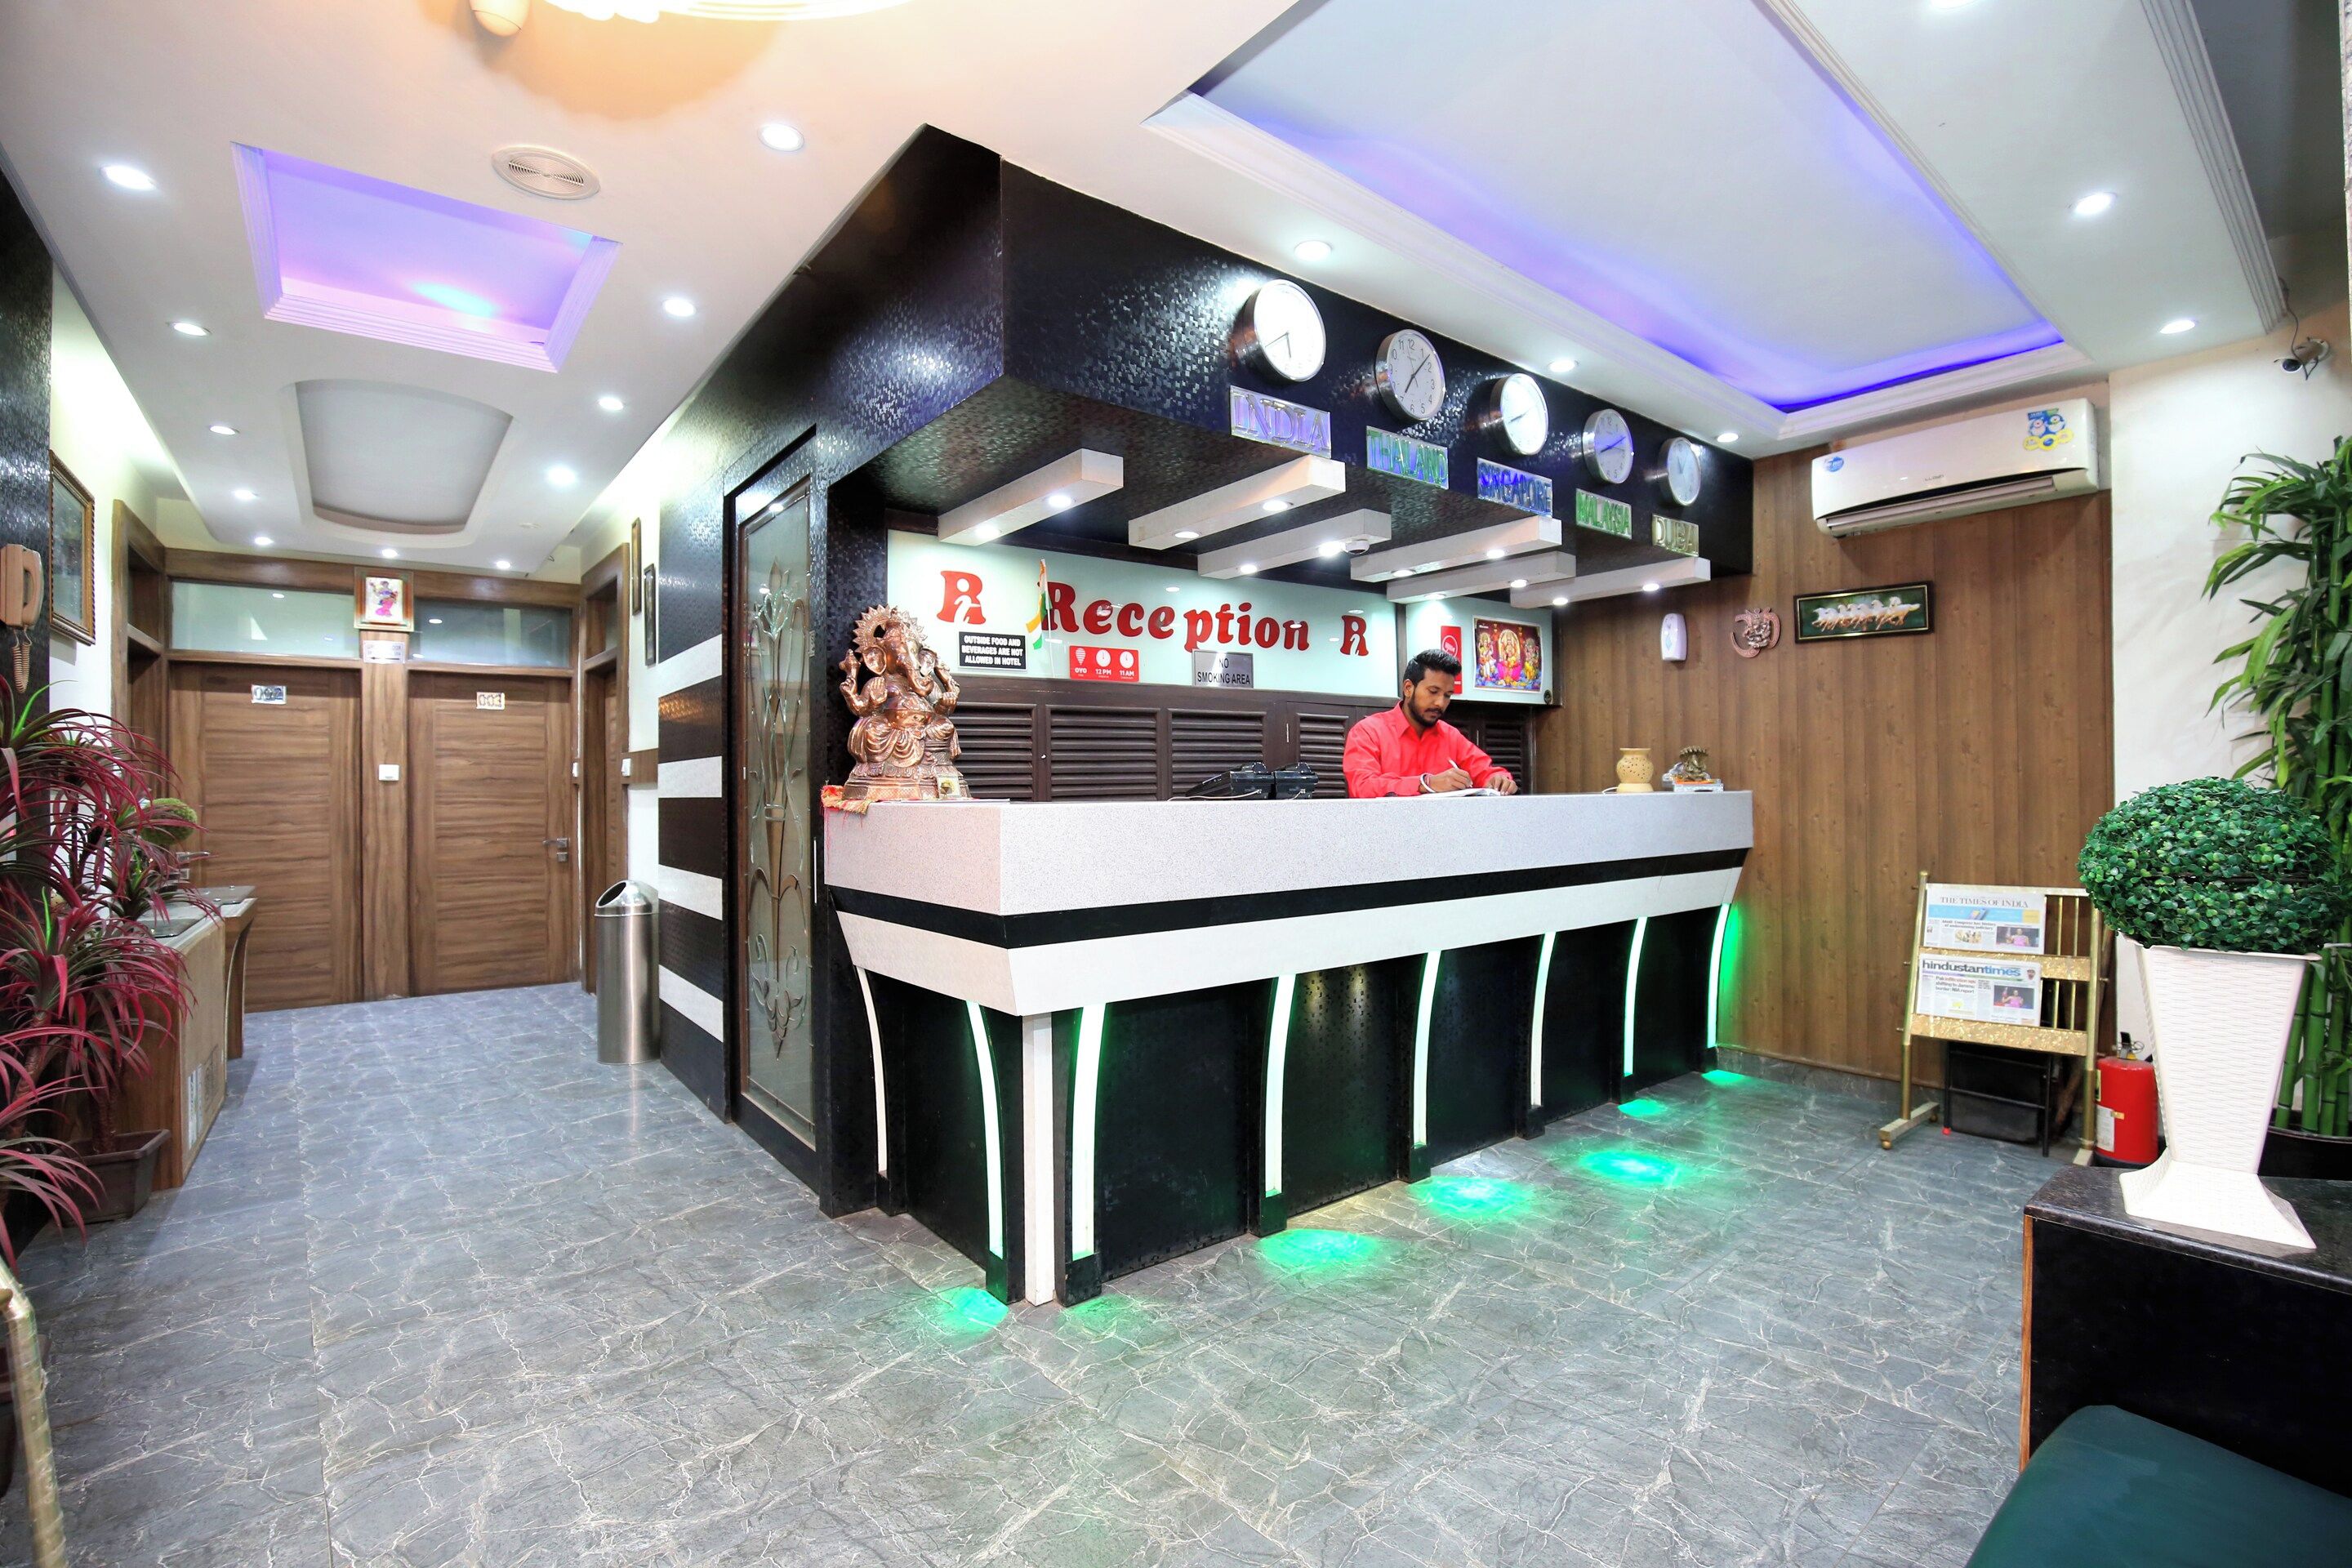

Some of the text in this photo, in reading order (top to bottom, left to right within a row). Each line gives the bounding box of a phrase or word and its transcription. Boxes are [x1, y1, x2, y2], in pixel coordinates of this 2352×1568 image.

[1232, 390, 1330, 454] INDIA
[1367, 430, 1448, 488] THAILAND
[1478, 461, 1552, 514] SINGAPORE
[1037, 581, 1310, 653] Reception
[964, 635, 1021, 647] OUTSIDE FOOD AND
[961, 645, 1023, 657] BEVERAGES ARE NOT
[964, 655, 993, 665] ALLOWED
[1001, 657, 1022, 666] HOTEL
[1219, 657, 1229, 668] NO
[1197, 671, 1251, 684] SMOKING AREA
[1960, 898, 1987, 906] TIMES
